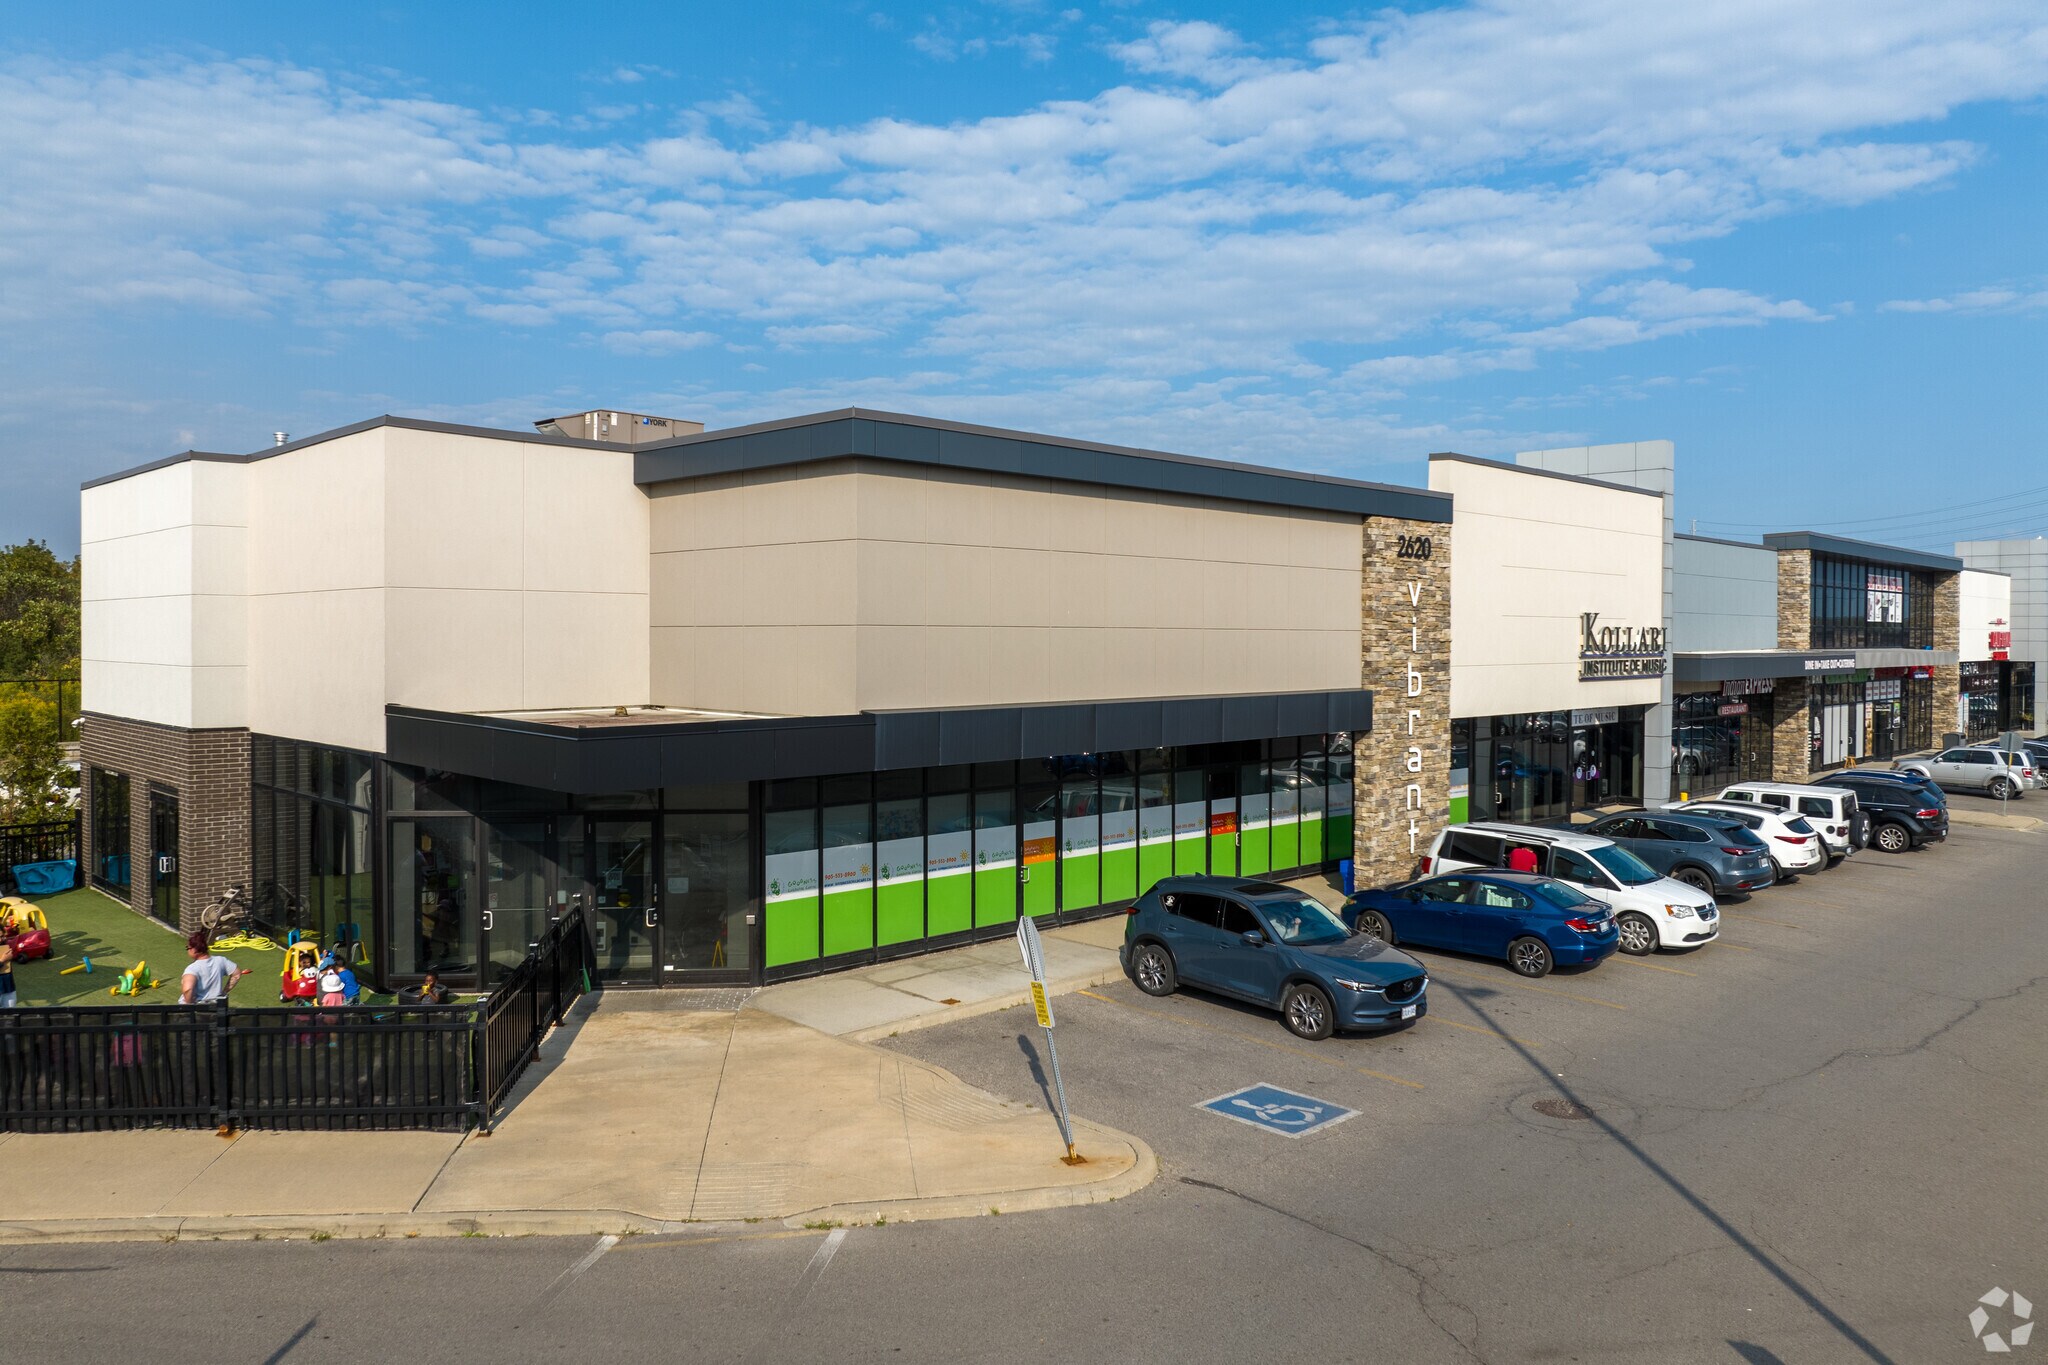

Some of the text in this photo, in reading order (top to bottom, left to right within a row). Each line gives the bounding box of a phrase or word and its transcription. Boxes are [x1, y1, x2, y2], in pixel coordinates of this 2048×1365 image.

[649, 419, 667, 427] YORK
[1397, 534, 1432, 560] 2620
[1582, 612, 1668, 653] KOLLARI
[1583, 658, 1668, 676] INSTITUTE OF MUSIC
[1406, 581, 1422, 854] vibrant
[1721, 703, 1748, 716] RESTAURANT
